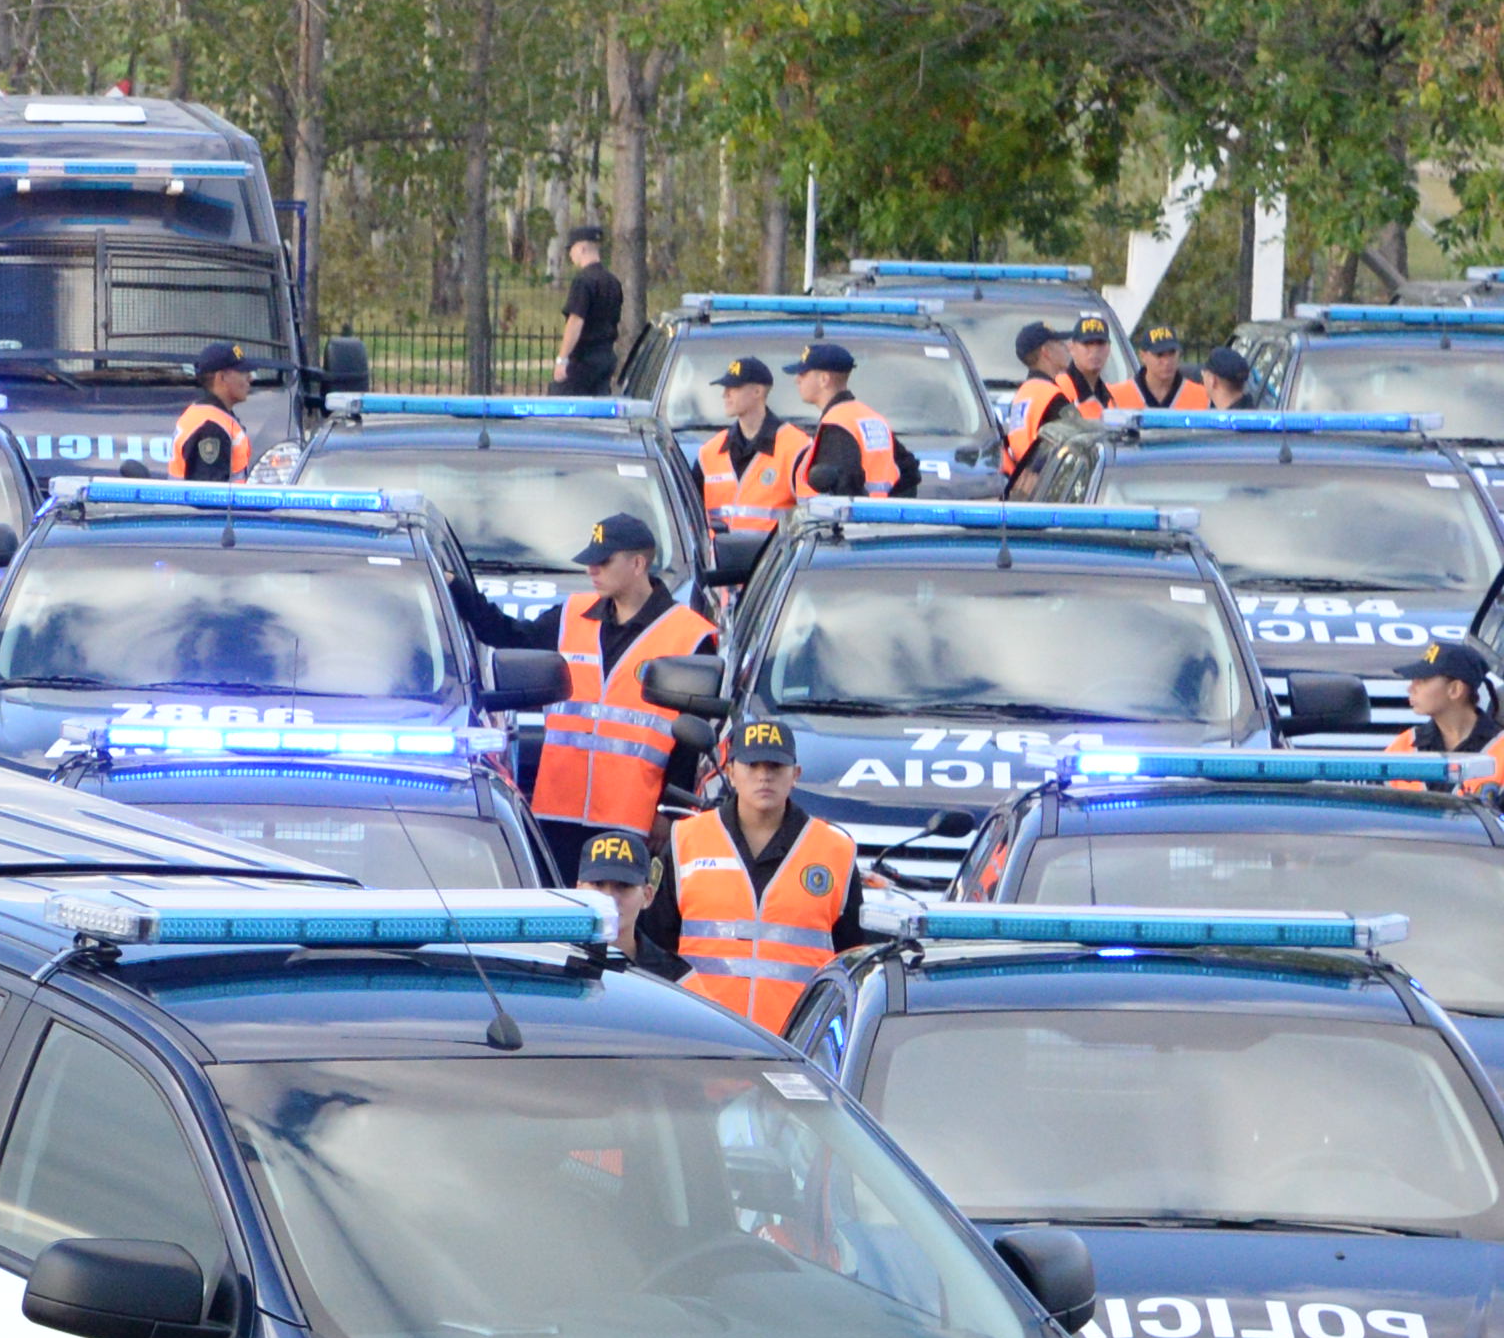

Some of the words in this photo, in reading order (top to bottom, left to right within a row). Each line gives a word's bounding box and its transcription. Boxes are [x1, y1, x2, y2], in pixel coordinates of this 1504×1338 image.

[744, 724, 782, 747] PFA
[591, 838, 632, 863] PFA
[695, 858, 717, 868] PFA
